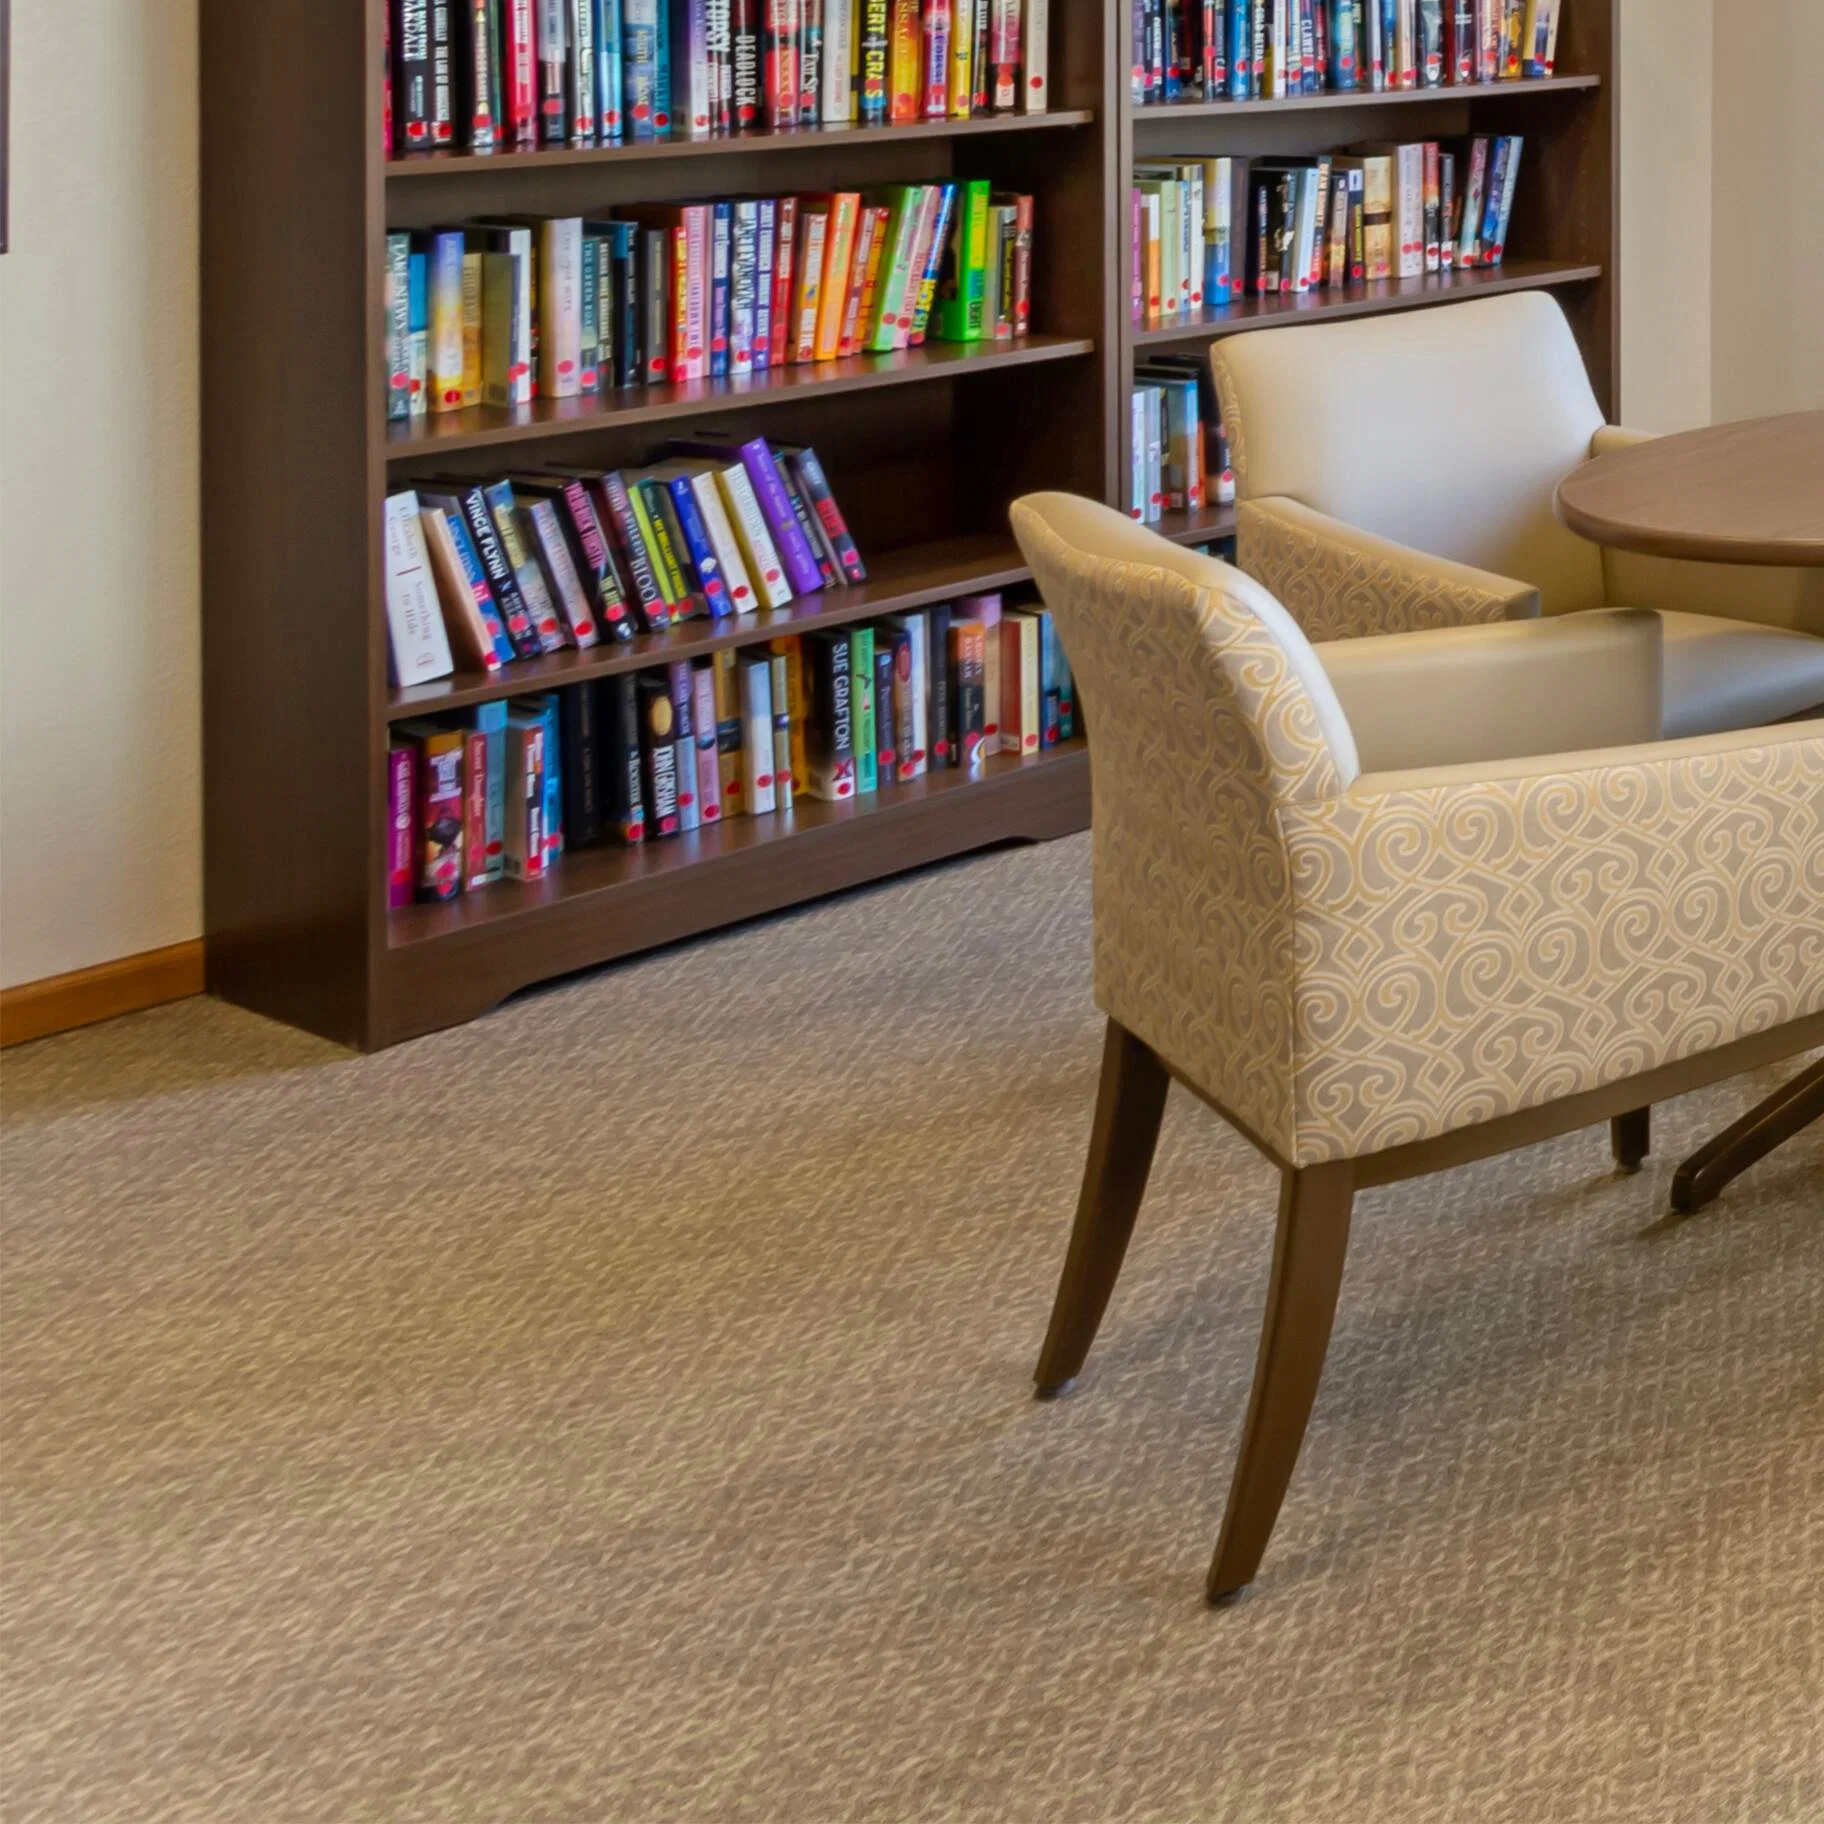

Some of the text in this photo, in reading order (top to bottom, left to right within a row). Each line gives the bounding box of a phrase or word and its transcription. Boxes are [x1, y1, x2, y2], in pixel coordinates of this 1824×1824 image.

[734, 34, 756, 106] DEADLOCK
[1318, 162, 1330, 189] DEAN
[465, 494, 506, 581] VINCE FLYNN
[832, 642, 850, 751] SUE GRAFTON
